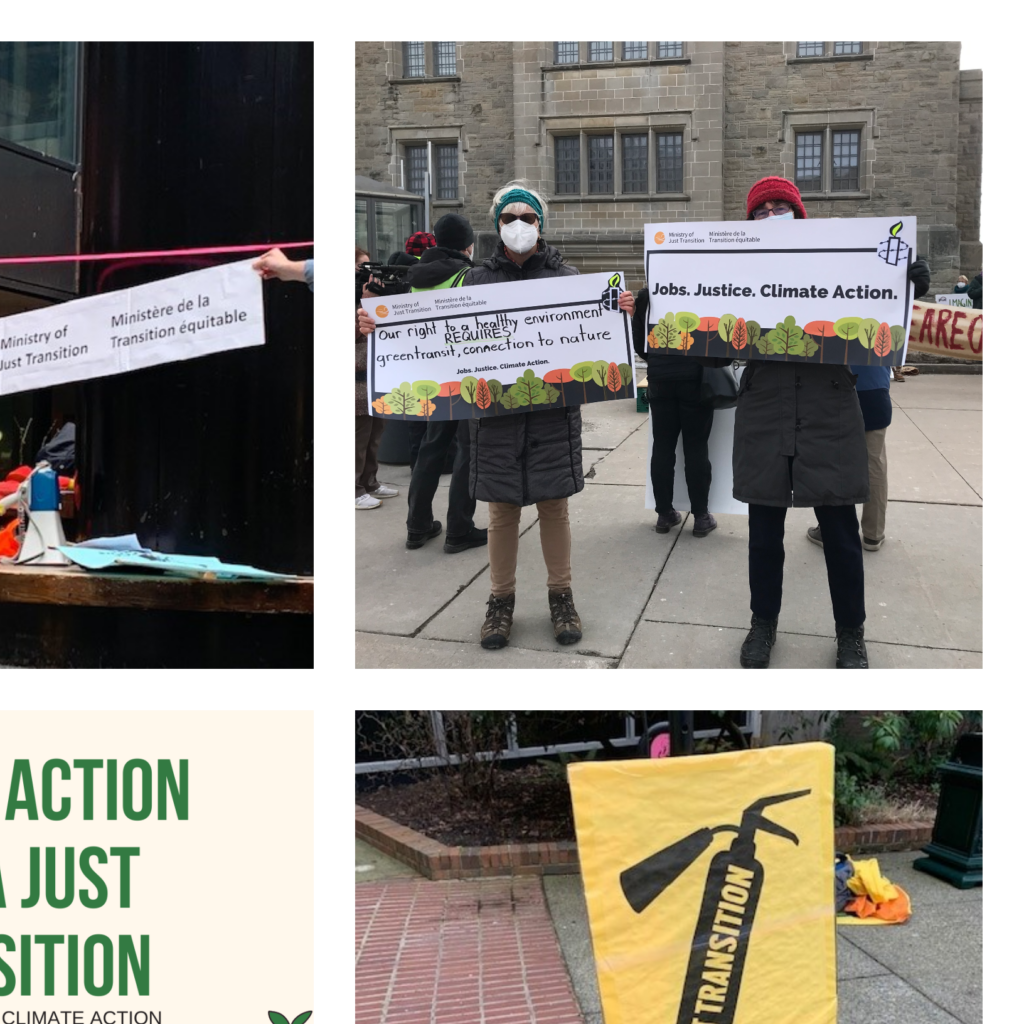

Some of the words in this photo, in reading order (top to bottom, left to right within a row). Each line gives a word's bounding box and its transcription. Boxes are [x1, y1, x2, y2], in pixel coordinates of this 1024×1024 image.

[435, 297, 458, 305] Ministère
[462, 300, 487, 308] équitable
[652, 283, 691, 296] Jobs.
[694, 283, 756, 298] Justice.
[760, 284, 829, 299] Climate
[832, 284, 898, 300] Action.
[111, 305, 174, 328] Ministère
[178, 299, 193, 312] de
[198, 294, 210, 308] la
[378, 329, 402, 341] Our
[408, 322, 437, 339] right
[444, 320, 456, 333] to
[461, 323, 470, 332] a
[475, 313, 518, 334] healthy
[524, 303, 604, 325] environment
[0, 330, 51, 350] Ministry
[55, 325, 68, 338] of
[110, 325, 175, 348] Transition
[179, 309, 247, 335] équitable
[444, 327, 512, 345] REQUIRES
[463, 338, 534, 356] connection
[538, 332, 554, 346] to
[560, 324, 612, 344] nature
[26, 343, 88, 366] Transition
[474, 364, 499, 373] Justice.
[499, 361, 526, 370] Climate
[527, 358, 550, 367] Action.
[5, 758, 189, 821] ACTION
[21, 846, 140, 909] JUST
[694, 864, 755, 1013] TRANSITION
